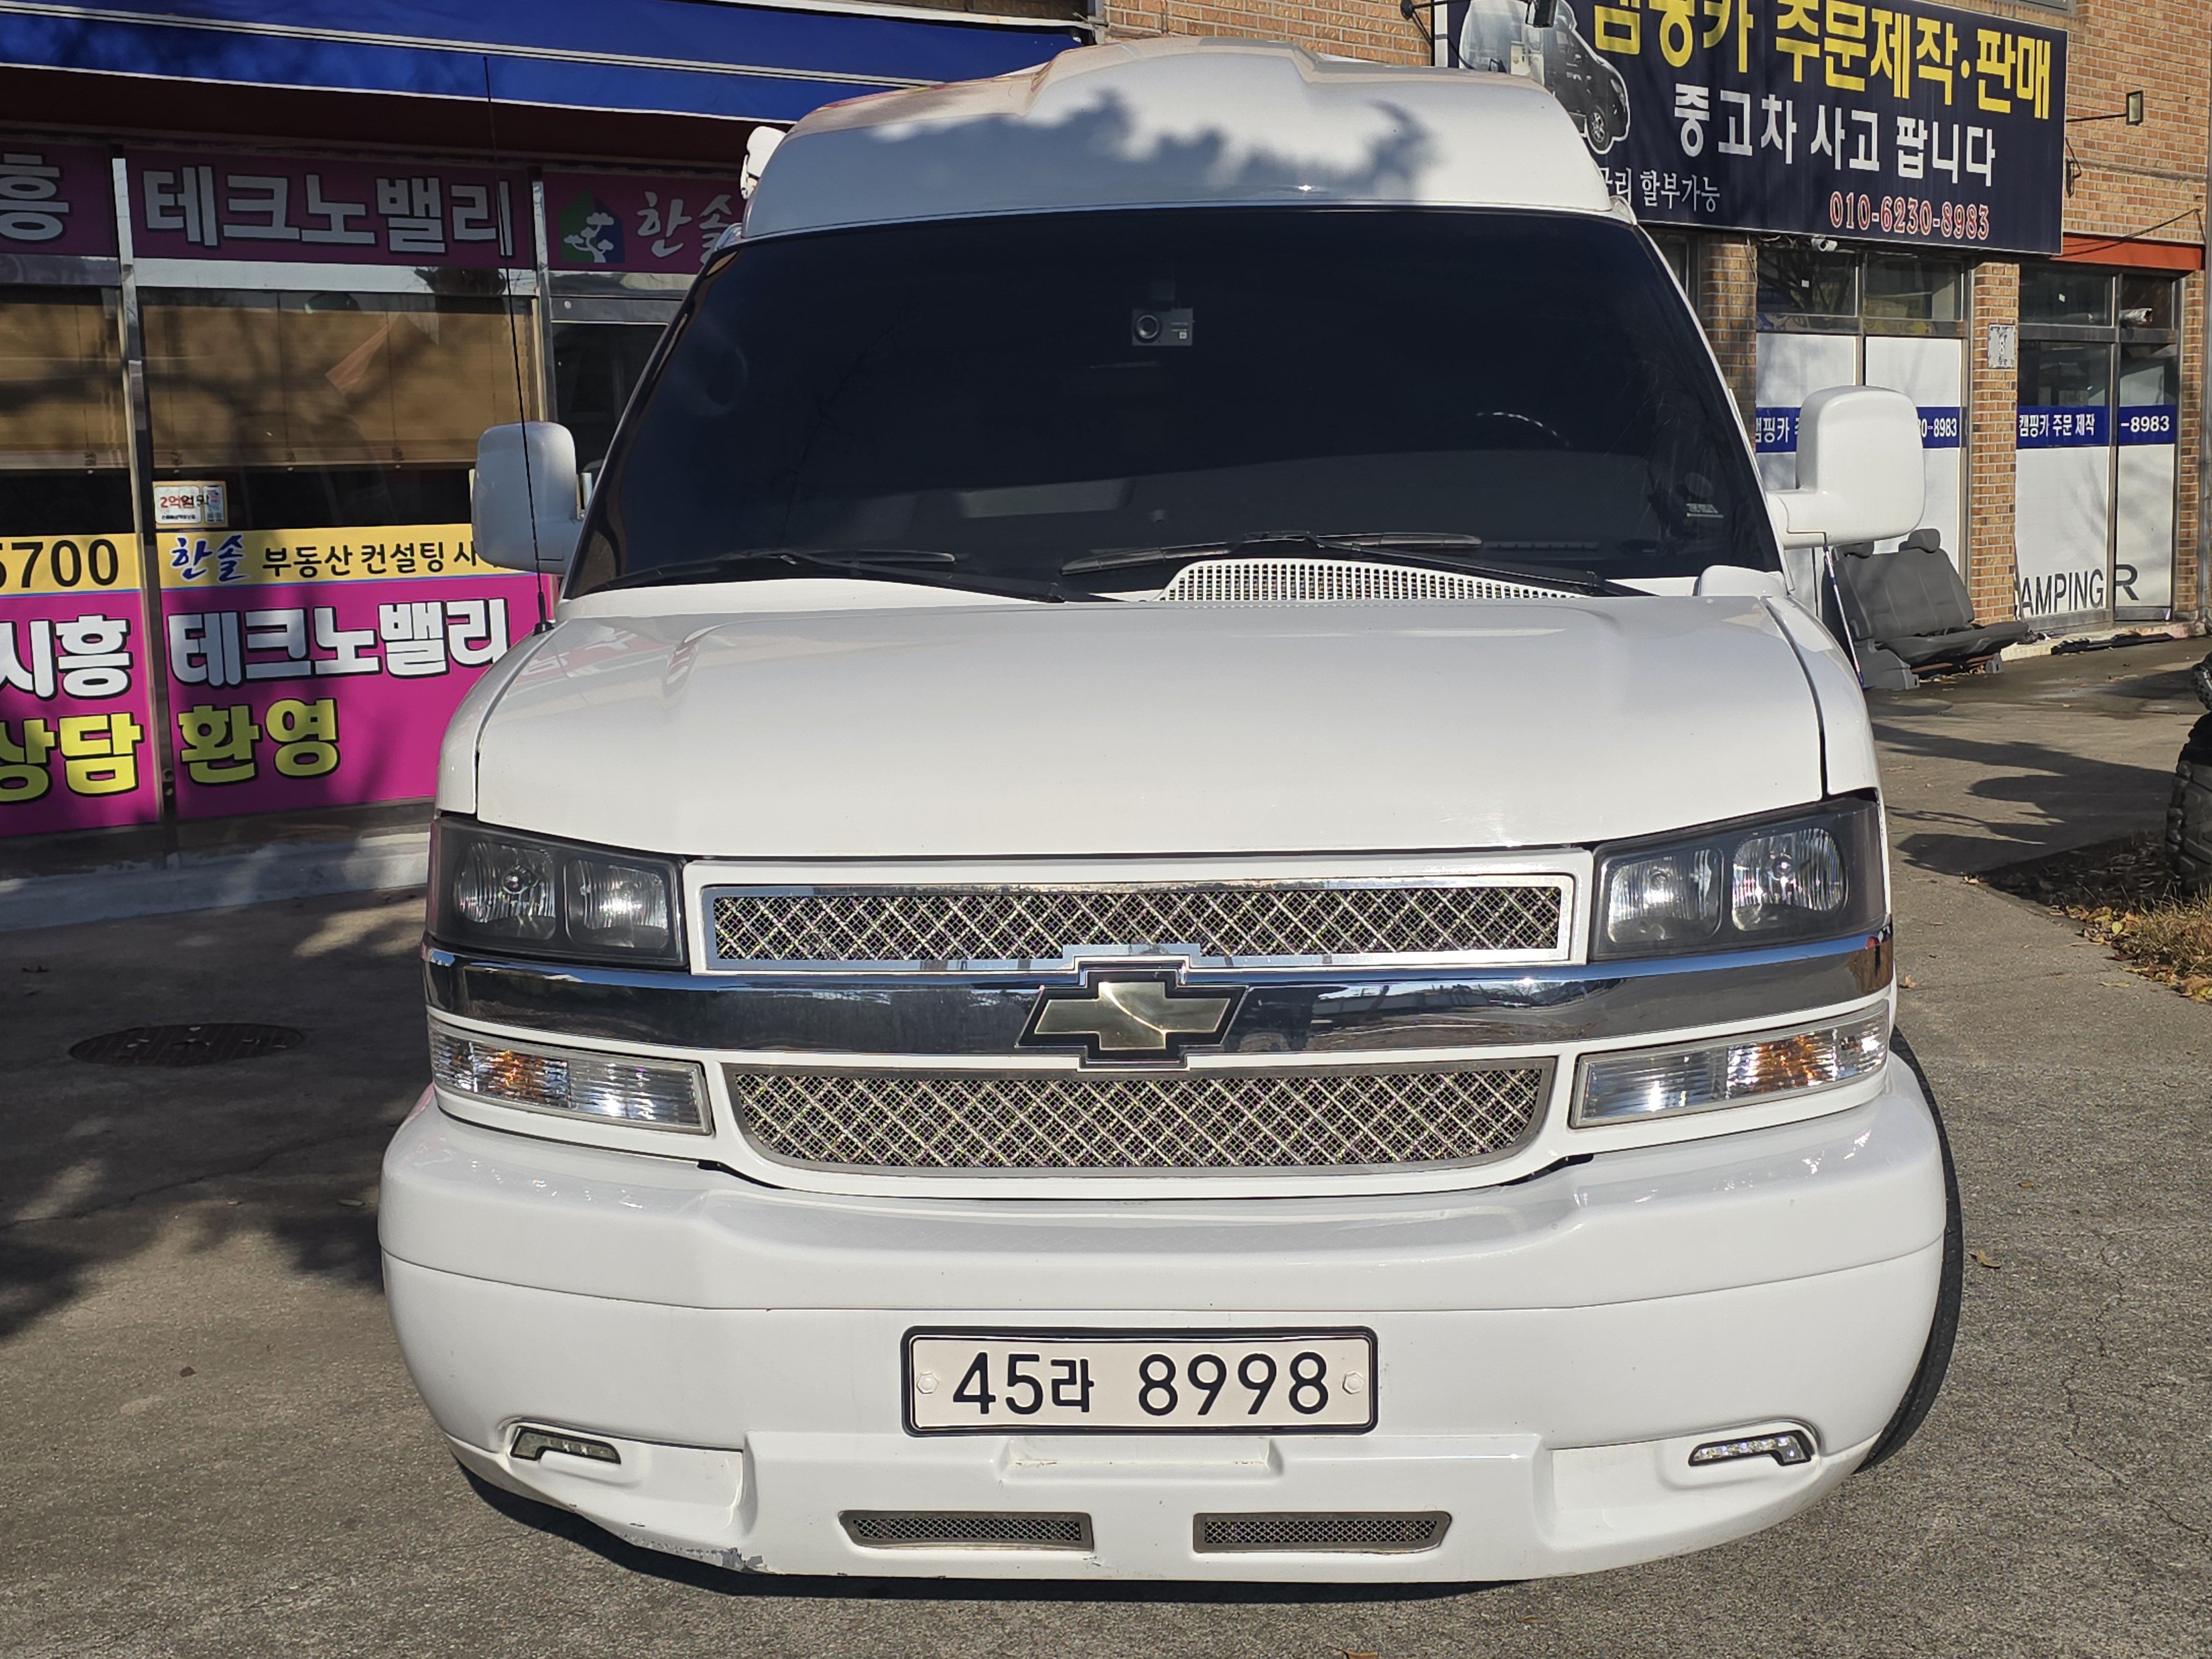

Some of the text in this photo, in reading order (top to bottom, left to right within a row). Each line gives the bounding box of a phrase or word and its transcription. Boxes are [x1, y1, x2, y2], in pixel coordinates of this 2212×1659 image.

[1674, 83, 1995, 187] 중고차 사고 팝니다
[143, 165, 513, 257] 테크노밸리
[1640, 170, 1720, 212] 할부가능
[1830, 191, 1990, 240] 010-6230-8983
[637, 191, 732, 264] 한솔
[2019, 414, 2095, 437] 캠핑카 주문 제작
[0, 539, 118, 588] 700
[169, 534, 251, 583] 한솔
[262, 546, 353, 577] 부동산
[360, 542, 445, 574] 컨설팅
[0, 598, 510, 700] 시흥 테크노밸리
[177, 698, 340, 785] 환영
[953, 1351, 1329, 1415] 45라 8998
